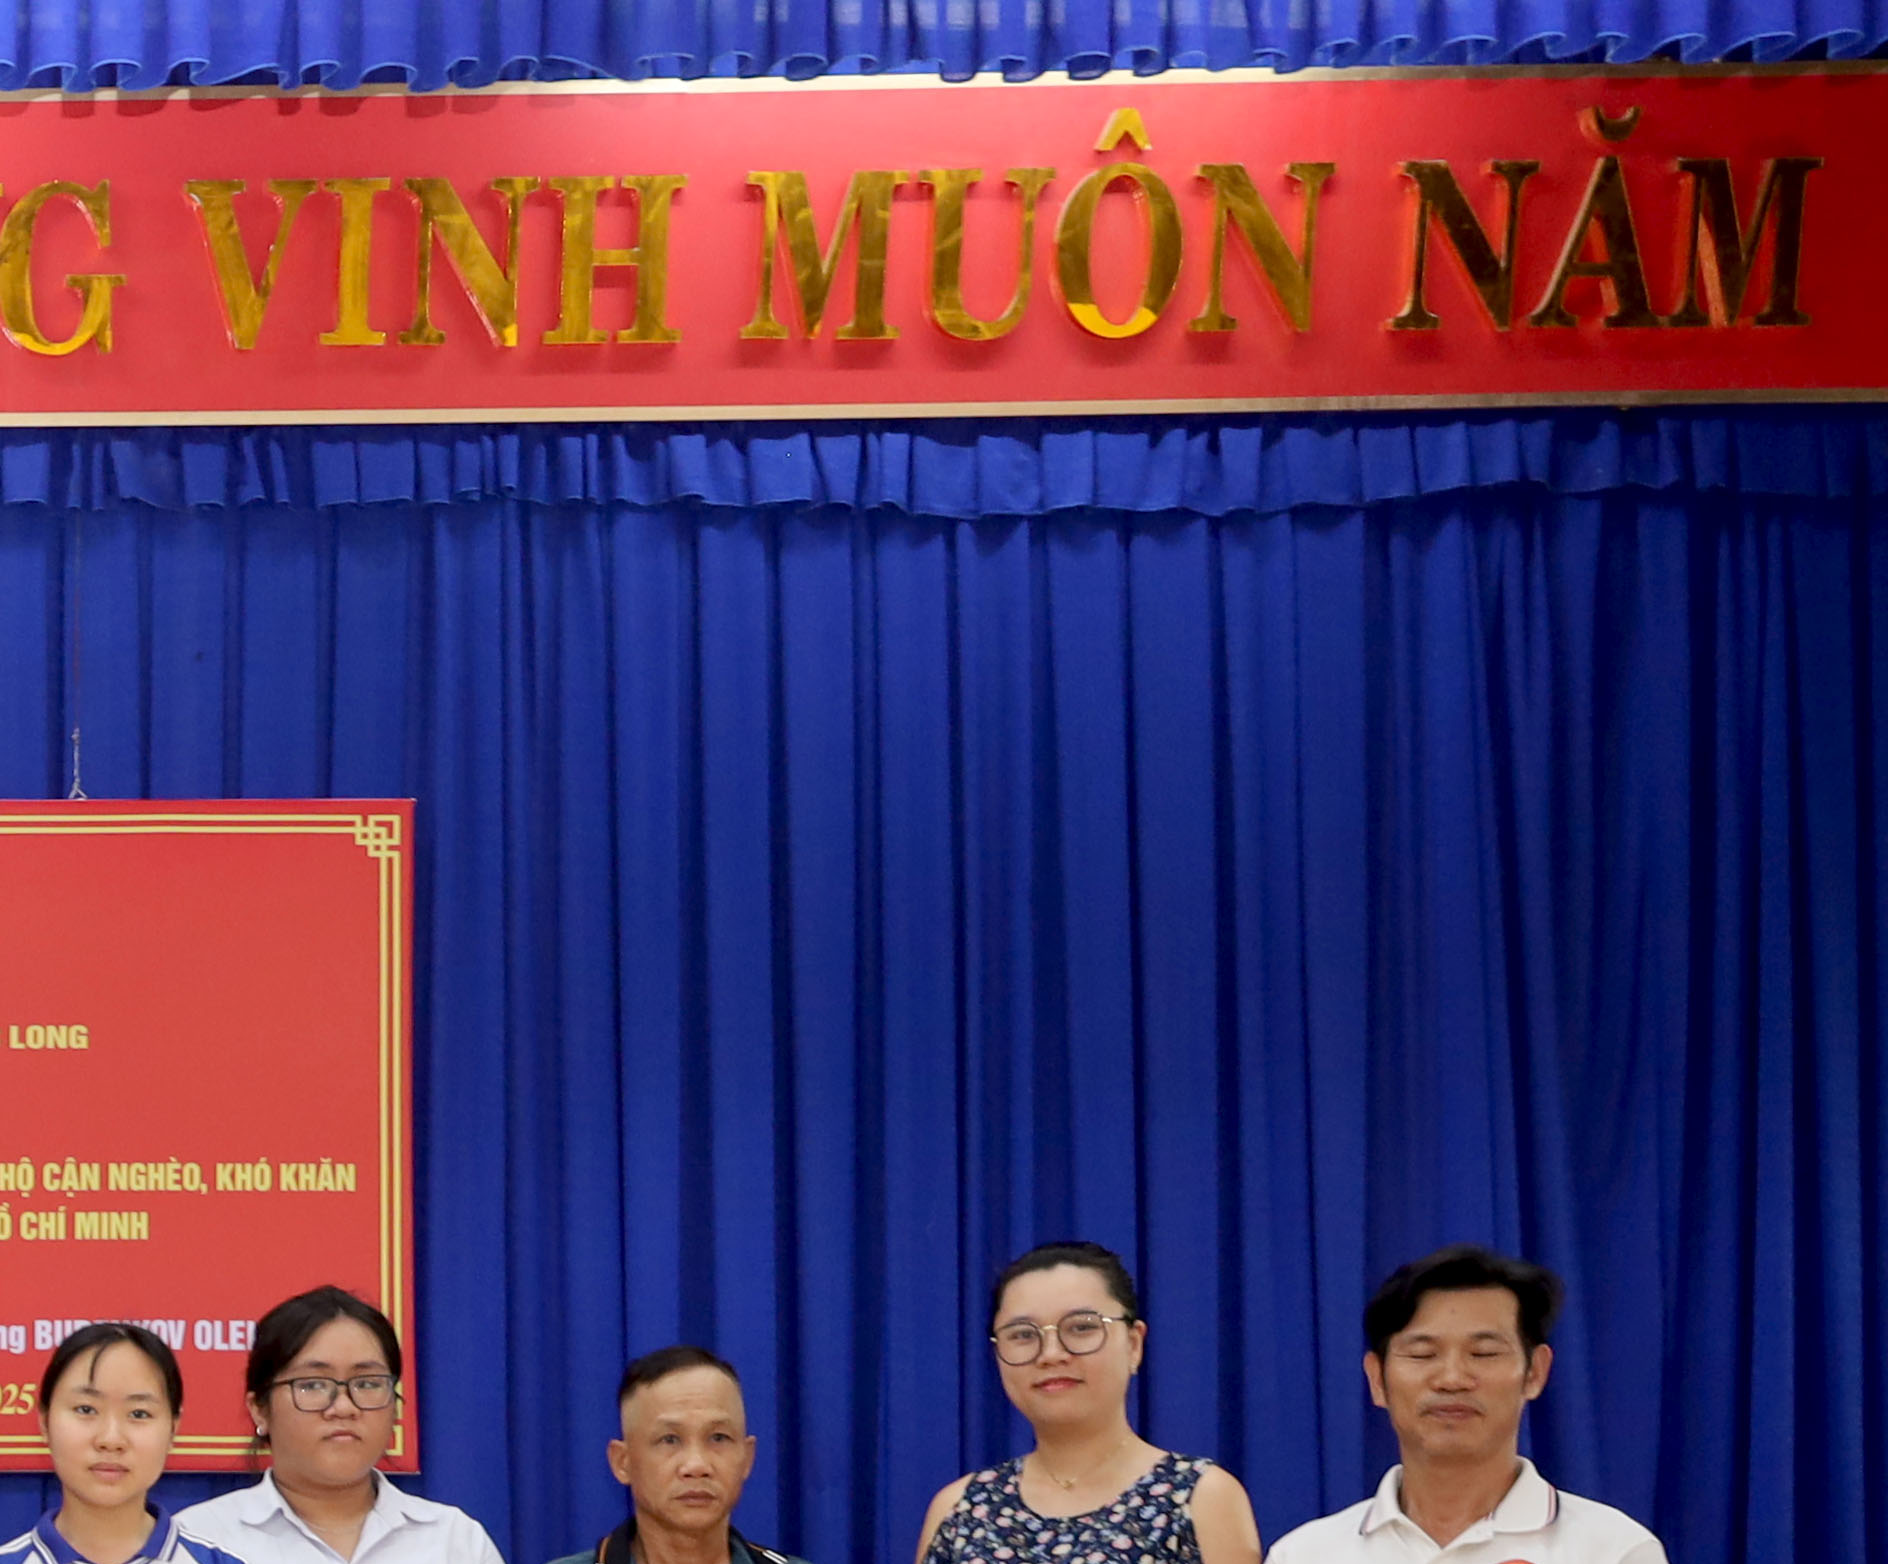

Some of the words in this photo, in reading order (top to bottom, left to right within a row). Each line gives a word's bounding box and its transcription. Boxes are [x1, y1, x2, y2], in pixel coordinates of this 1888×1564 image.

[183, 172, 690, 348] VINH
[741, 107, 1336, 342] MUÔN
[1388, 104, 1822, 334] NĂM
[10, 1025, 88, 1049] LONG
[43, 1157, 100, 1197] CẬN
[109, 1157, 208, 1194] NGHÈO,
[216, 1157, 272, 1191] KHÓ
[280, 1158, 355, 1191] KHĂN
[20, 1206, 66, 1240] CHÍ
[75, 1212, 148, 1240] MINH
